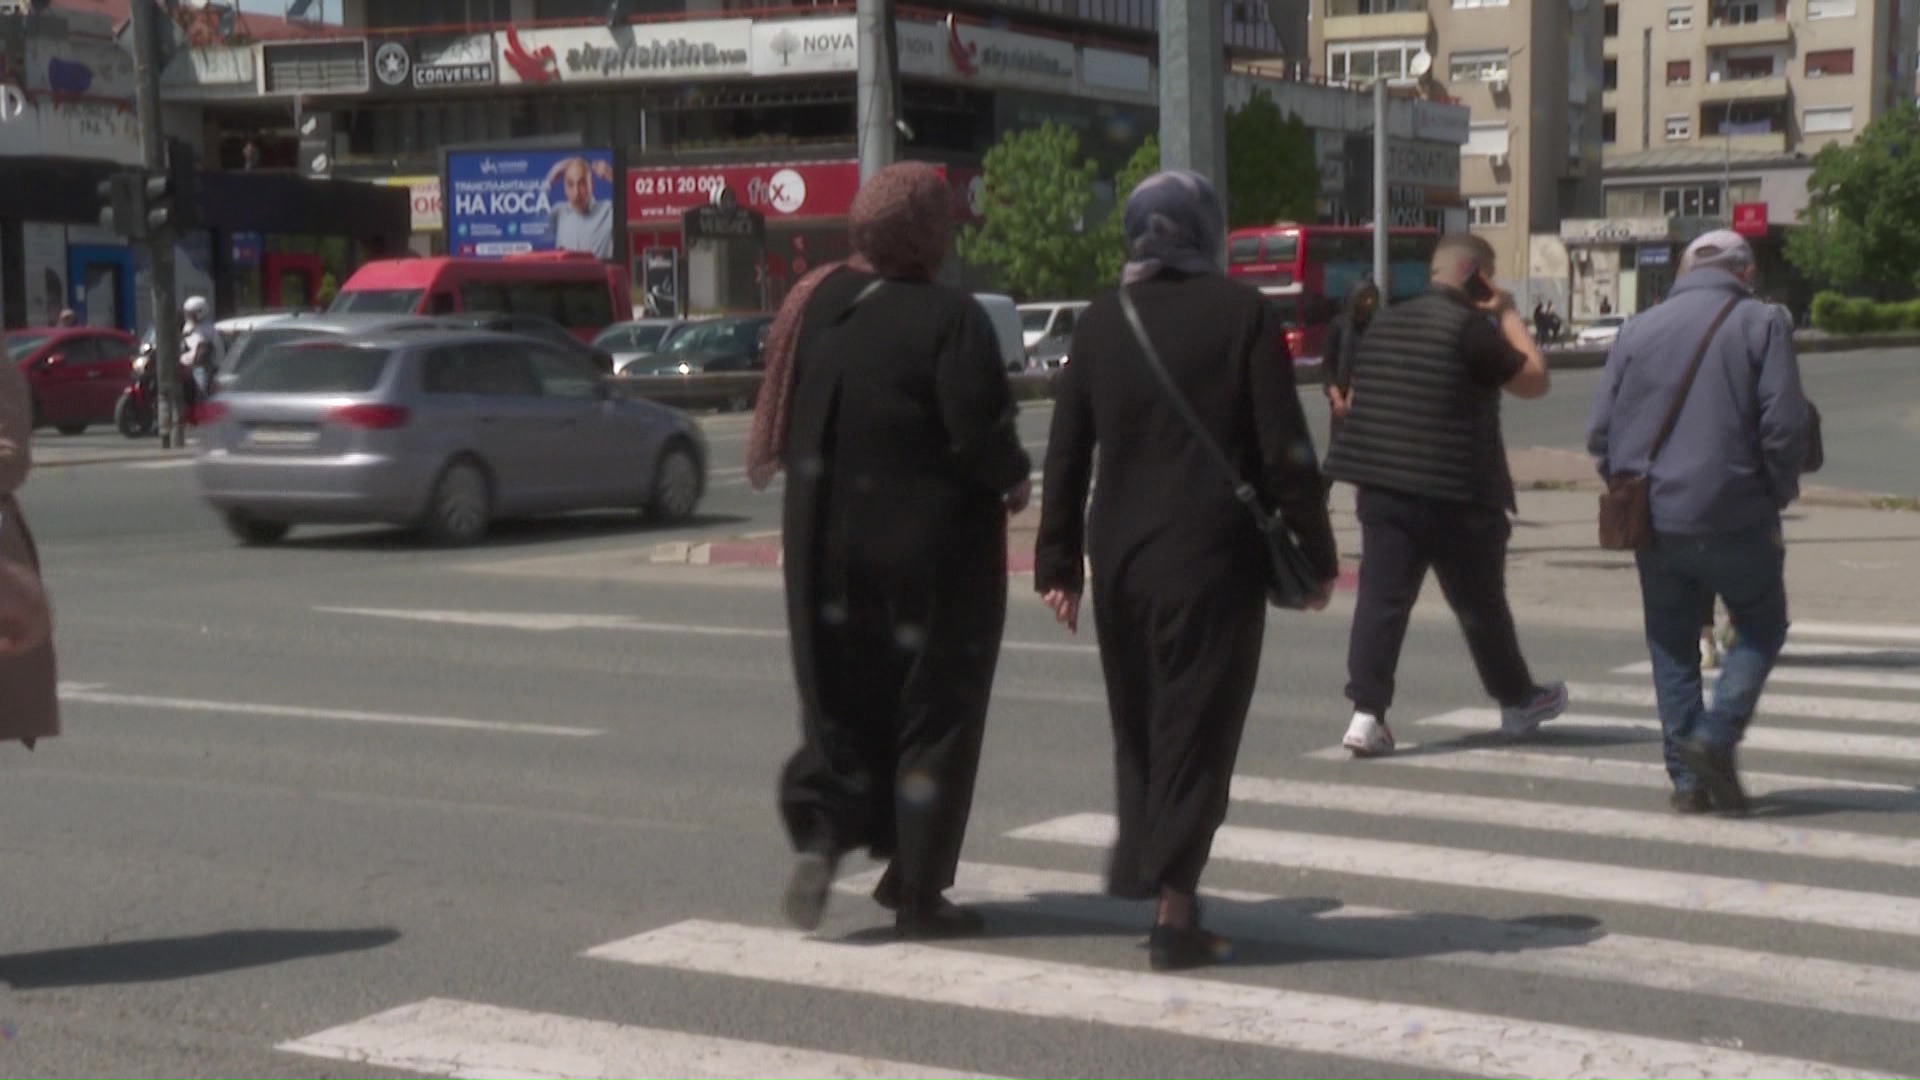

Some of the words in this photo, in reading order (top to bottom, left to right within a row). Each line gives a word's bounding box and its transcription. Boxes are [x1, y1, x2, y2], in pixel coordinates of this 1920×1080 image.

[803, 33, 854, 52] NOVA
[417, 66, 490, 83] CONVERSE
[635, 177, 654, 195] 02
[656, 177, 674, 194] 51
[677, 176, 697, 194] 20
[455, 193, 487, 215] НА
[490, 190, 552, 215] КОСА
